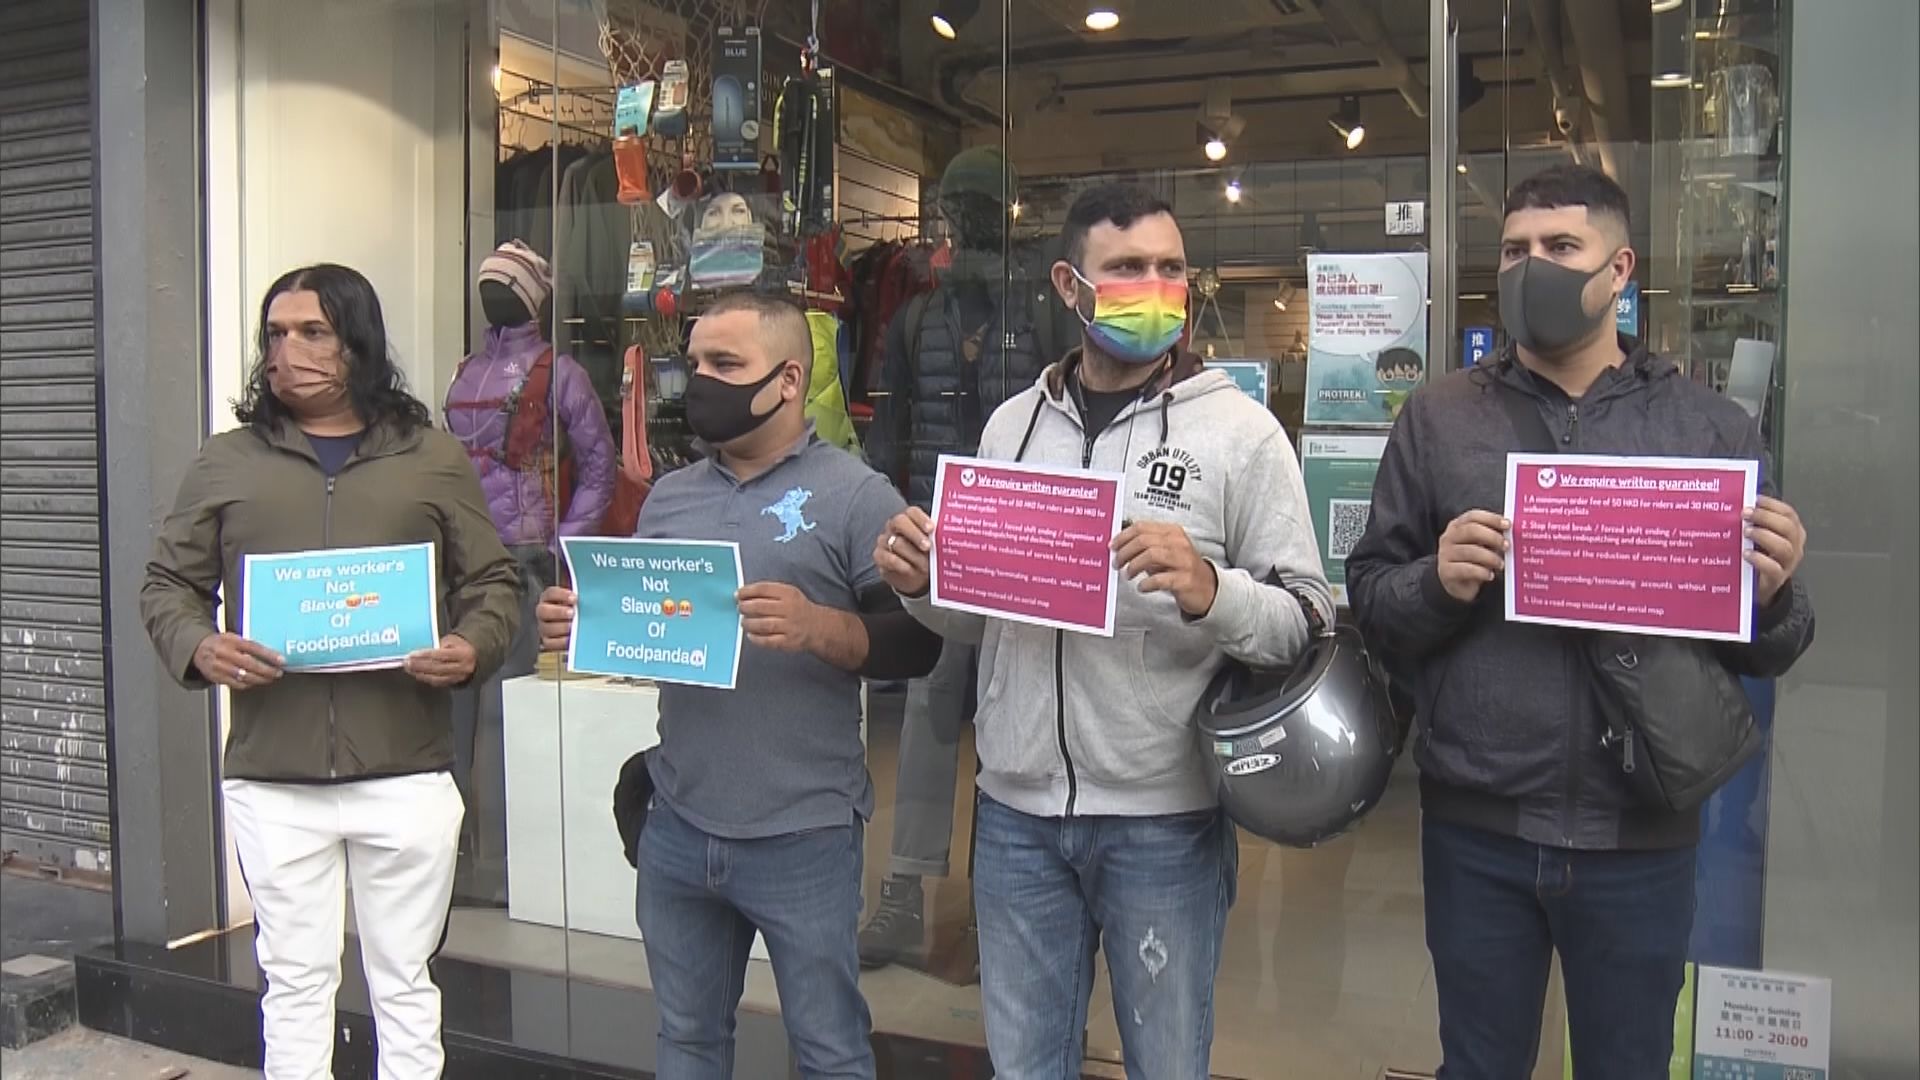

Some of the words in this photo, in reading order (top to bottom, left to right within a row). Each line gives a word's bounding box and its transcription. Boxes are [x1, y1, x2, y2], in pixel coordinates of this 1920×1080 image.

[725, 48, 747, 56] BLUE
[1396, 204, 1413, 221] 推
[1136, 446, 1170, 469] URBAN
[1172, 447, 1202, 481] UTILITY
[977, 473, 991, 486] We
[991, 476, 1021, 490] require
[1022, 479, 1051, 494] written
[1052, 483, 1098, 499] guarantee!!
[1149, 462, 1186, 491] 09
[1560, 473, 1577, 486] We
[1579, 474, 1615, 488] require
[1618, 475, 1656, 489] written
[1658, 476, 1719, 492] guarantee!!
[957, 492, 982, 502] minimum
[983, 495, 997, 504] order
[998, 496, 1006, 505] fee
[1023, 499, 1036, 509] HKD
[1037, 501, 1045, 510] for
[1046, 502, 1062, 512] riders
[1063, 504, 1073, 513] and
[1083, 507, 1096, 516] HKD
[1097, 508, 1105, 517] for
[1523, 505, 1548, 513] walkers
[1550, 506, 1562, 514] and
[1564, 507, 1588, 516] cyclists
[1536, 495, 1567, 504] minimum
[1569, 496, 1587, 505] order
[1589, 497, 1601, 505] fee
[1602, 497, 1610, 506] of
[1611, 498, 1621, 506] 50
[1623, 498, 1638, 507] HKD
[1640, 499, 1650, 507] for
[1652, 499, 1673, 508] riders
[1676, 500, 1689, 509] and
[1690, 501, 1700, 510] 30
[1702, 501, 1718, 510] HKD
[1720, 502, 1731, 511] for
[950, 514, 962, 525] Stop
[964, 516, 981, 526] forced
[982, 518, 997, 528] break
[1004, 521, 1022, 531] forced
[1024, 524, 1036, 533] shift
[1037, 526, 1056, 538] ending
[1063, 530, 1094, 542] suspension
[1530, 520, 1545, 531] Stop
[1547, 521, 1569, 530] forced
[1572, 522, 1591, 531] break
[1601, 524, 1624, 533] forced
[1627, 525, 1641, 534] shift
[1645, 526, 1669, 537] ending
[1679, 529, 1720, 540] suspension
[1723, 530, 1730, 539] of
[1521, 530, 1550, 539] accounts
[1553, 532, 1570, 540] when
[1621, 536, 1633, 544] and
[1635, 536, 1667, 547] declining
[1669, 538, 1692, 547] orders
[947, 538, 979, 549] Cancellation
[988, 544, 996, 552] the
[998, 545, 1024, 556] reduction
[1033, 550, 1052, 560] service
[1055, 553, 1067, 562] fees
[1068, 555, 1077, 563] for
[1079, 557, 1101, 567] stacked
[1523, 556, 1543, 564] orders
[1529, 546, 1570, 556] Cancellation
[1573, 549, 1580, 557] of
[1582, 549, 1593, 558] the
[1596, 550, 1630, 560] reduction
[1632, 552, 1639, 560] of
[1642, 553, 1667, 562] service
[1669, 555, 1685, 563] fees
[1687, 556, 1698, 564] for
[1701, 556, 1730, 566] stacked
[275, 568, 301, 581] We
[307, 567, 332, 579] are
[337, 560, 405, 576] worker's
[592, 553, 617, 567] We
[622, 557, 645, 569] are
[649, 558, 714, 573] worker's
[326, 581, 355, 595] Not
[642, 576, 669, 593] Not
[1032, 574, 1056, 584] accounts
[1060, 579, 1081, 588] without
[1085, 583, 1100, 593] good
[1533, 572, 1547, 581] Stop
[1640, 579, 1672, 588] accounts
[1678, 581, 1705, 591] without
[1711, 584, 1730, 594] good
[301, 599, 345, 613] Slave
[621, 597, 662, 614] Slave
[1530, 596, 1542, 604] Use
[1549, 597, 1563, 606] road
[1566, 600, 1580, 608] map
[1582, 600, 1606, 609] instead
[1608, 602, 1615, 610] of
[1627, 604, 1646, 613] aerial
[1648, 607, 1663, 615] map
[331, 614, 350, 628] Of
[648, 622, 666, 639] Of
[286, 629, 381, 655] Foodpanda
[607, 641, 690, 664] Foodpanda
[1724, 1000, 1758, 1013] Monday
[1768, 1006, 1801, 1018] Sunday
[1715, 1027, 1754, 1041] 11:00
[1768, 1032, 1809, 1048] 20:00
